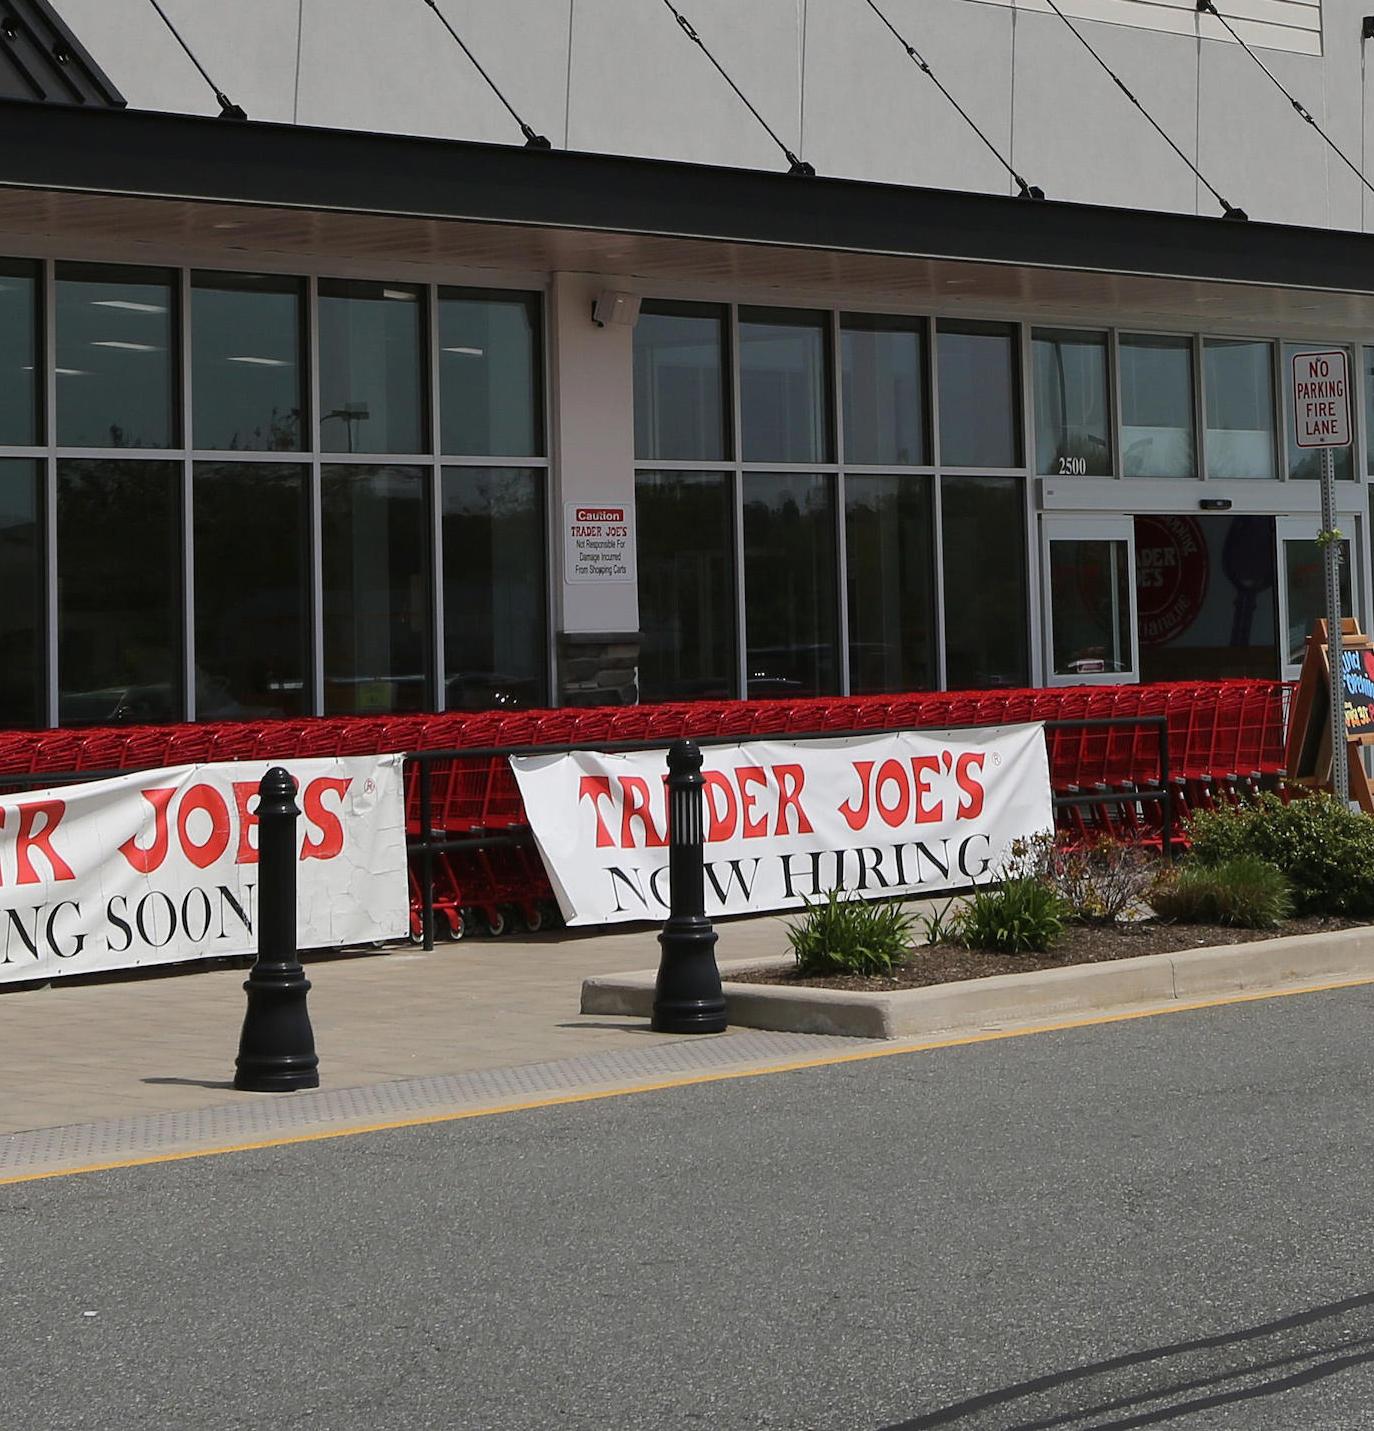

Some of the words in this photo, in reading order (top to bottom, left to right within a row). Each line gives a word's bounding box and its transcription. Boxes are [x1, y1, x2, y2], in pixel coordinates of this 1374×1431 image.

[1309, 360, 1329, 378] NO
[1297, 380, 1343, 399] PARKING
[1306, 402, 1336, 417] FIRE
[1306, 420, 1338, 435] LANE
[1058, 456, 1086, 475] 2500
[578, 510, 620, 521] Caution
[571, 526, 602, 537] TRADER
[616, 539, 625, 548] For
[579, 764, 814, 848] TRDER
[838, 750, 986, 831] JOE'S
[778, 833, 992, 898] HIRING
[106, 883, 256, 953] SOON
